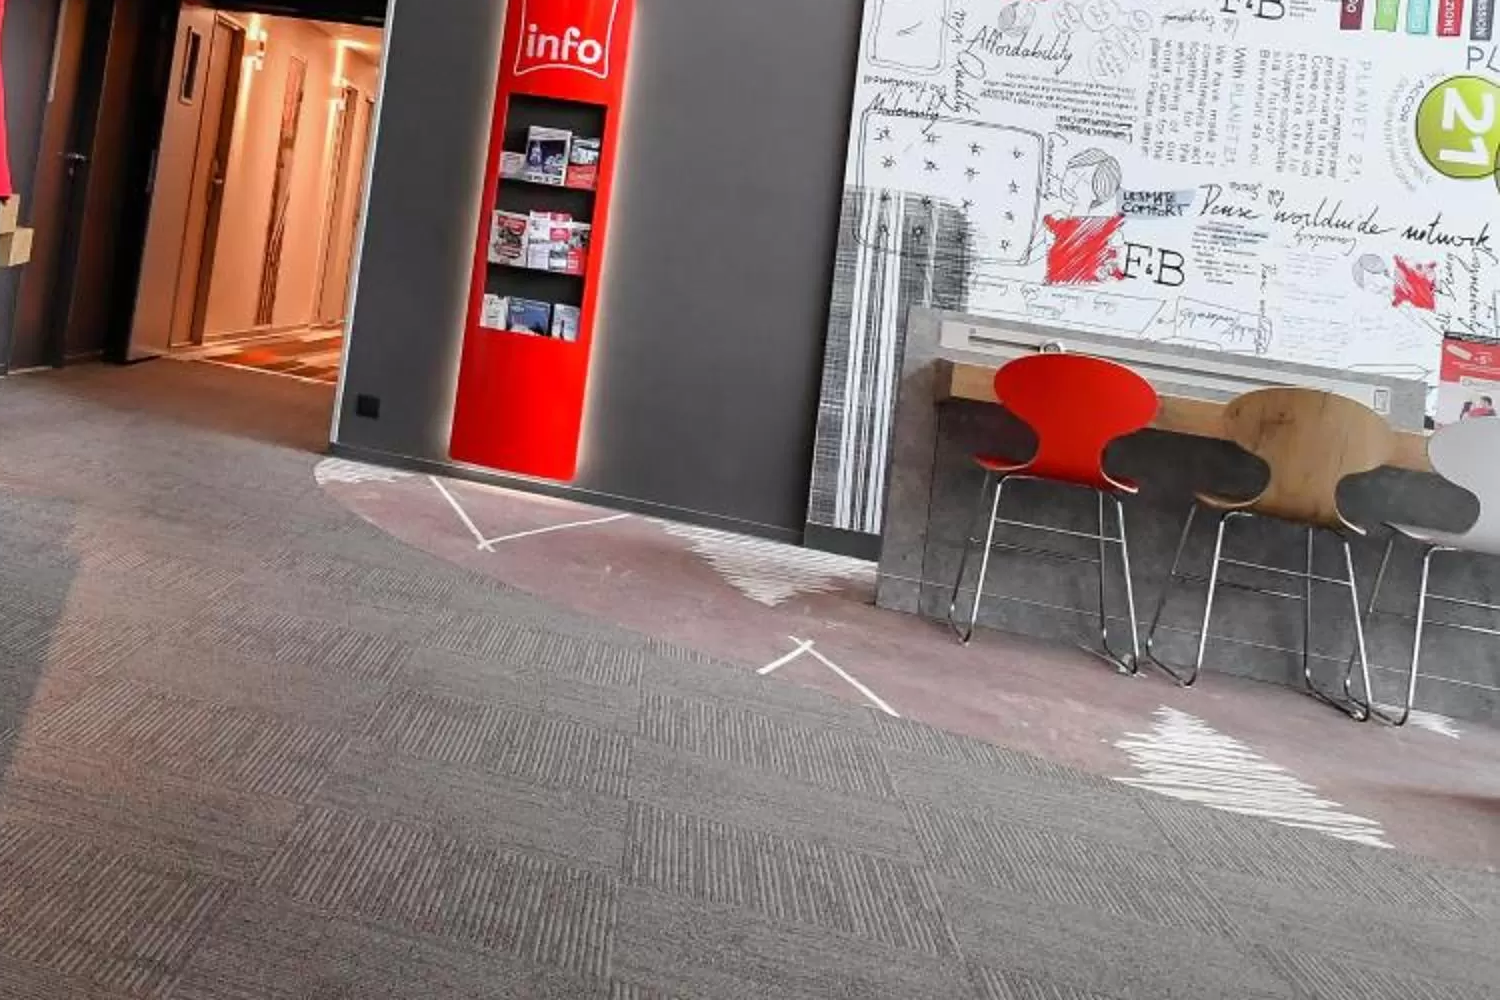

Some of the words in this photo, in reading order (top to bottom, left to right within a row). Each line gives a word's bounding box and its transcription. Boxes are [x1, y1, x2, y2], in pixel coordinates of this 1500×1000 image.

[526, 23, 603, 65] info
[966, 25, 1073, 75] Affordability
[1436, 86, 1496, 167] 21
[1273, 196, 1397, 235] worldwide
[1401, 211, 1493, 250] network
[1123, 241, 1186, 287] F&B
